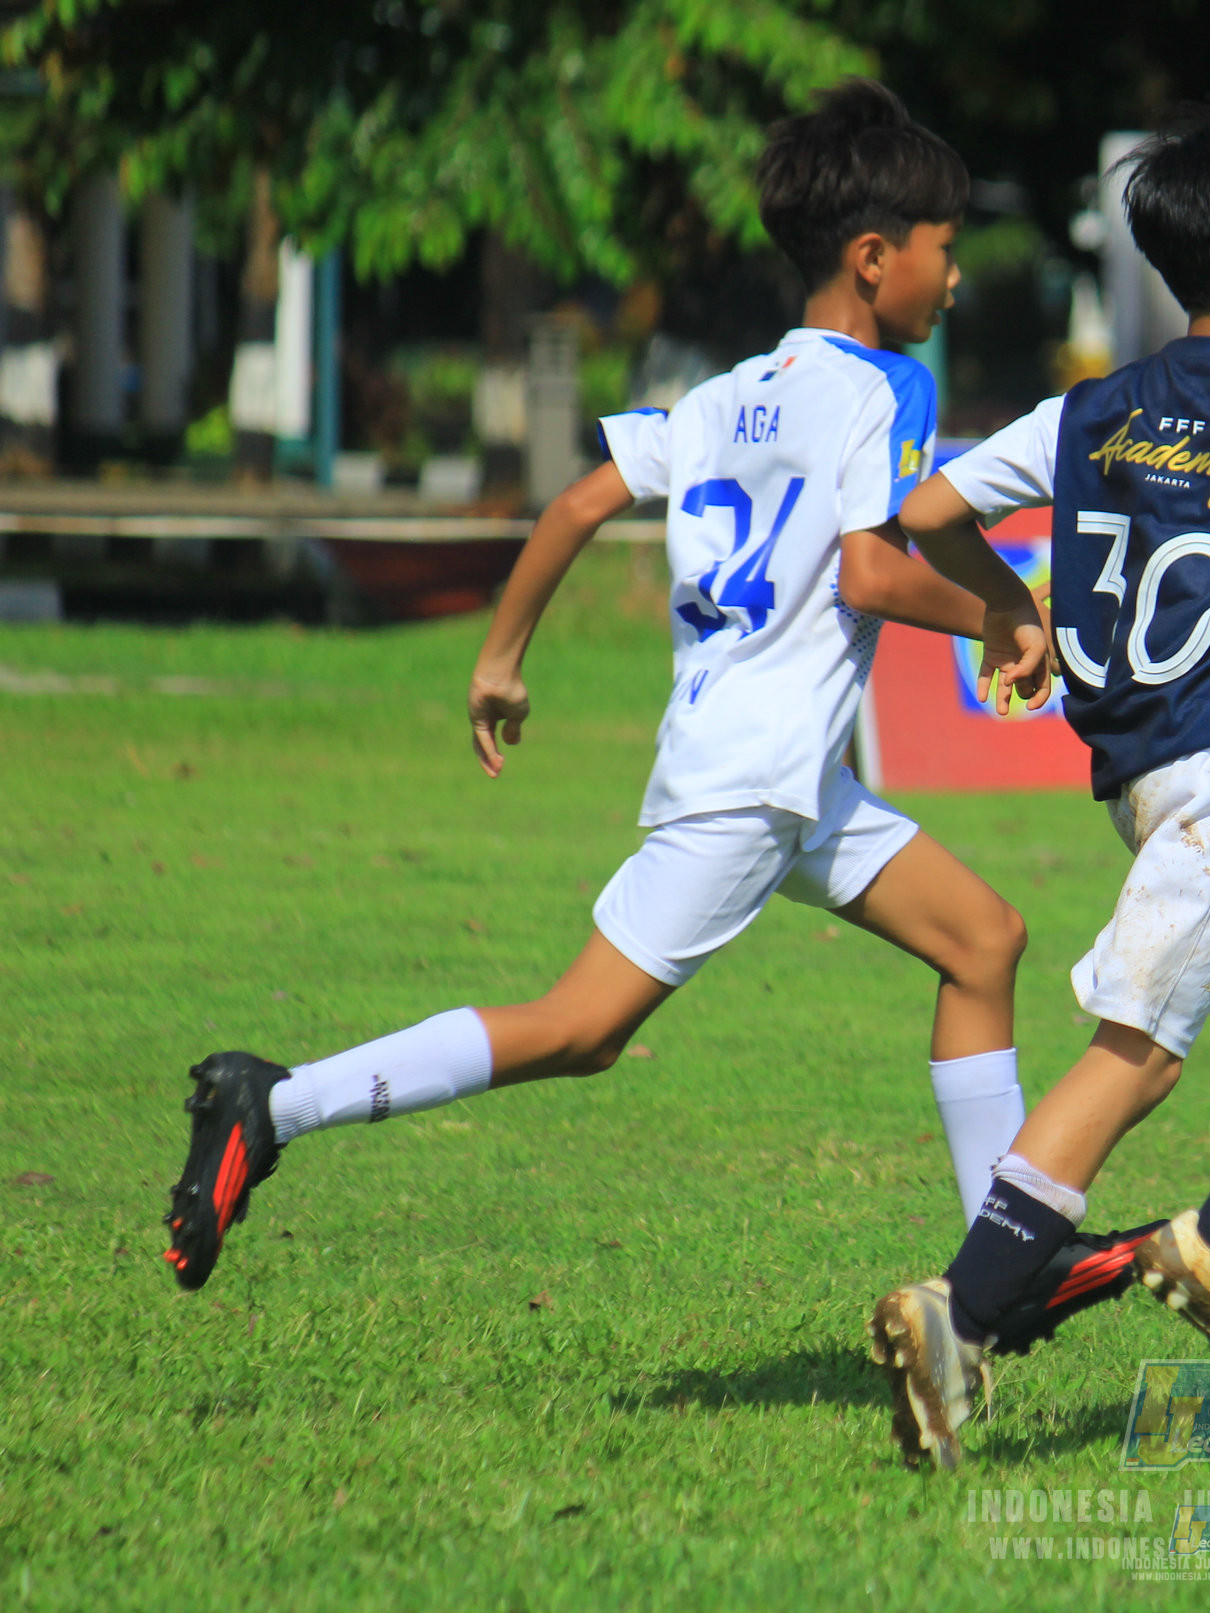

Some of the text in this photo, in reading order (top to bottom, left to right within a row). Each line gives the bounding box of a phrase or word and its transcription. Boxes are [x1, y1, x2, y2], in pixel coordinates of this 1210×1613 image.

[733, 404, 781, 443] AGA
[1158, 416, 1206, 435] FFF
[1144, 473, 1191, 489] JAKARTA
